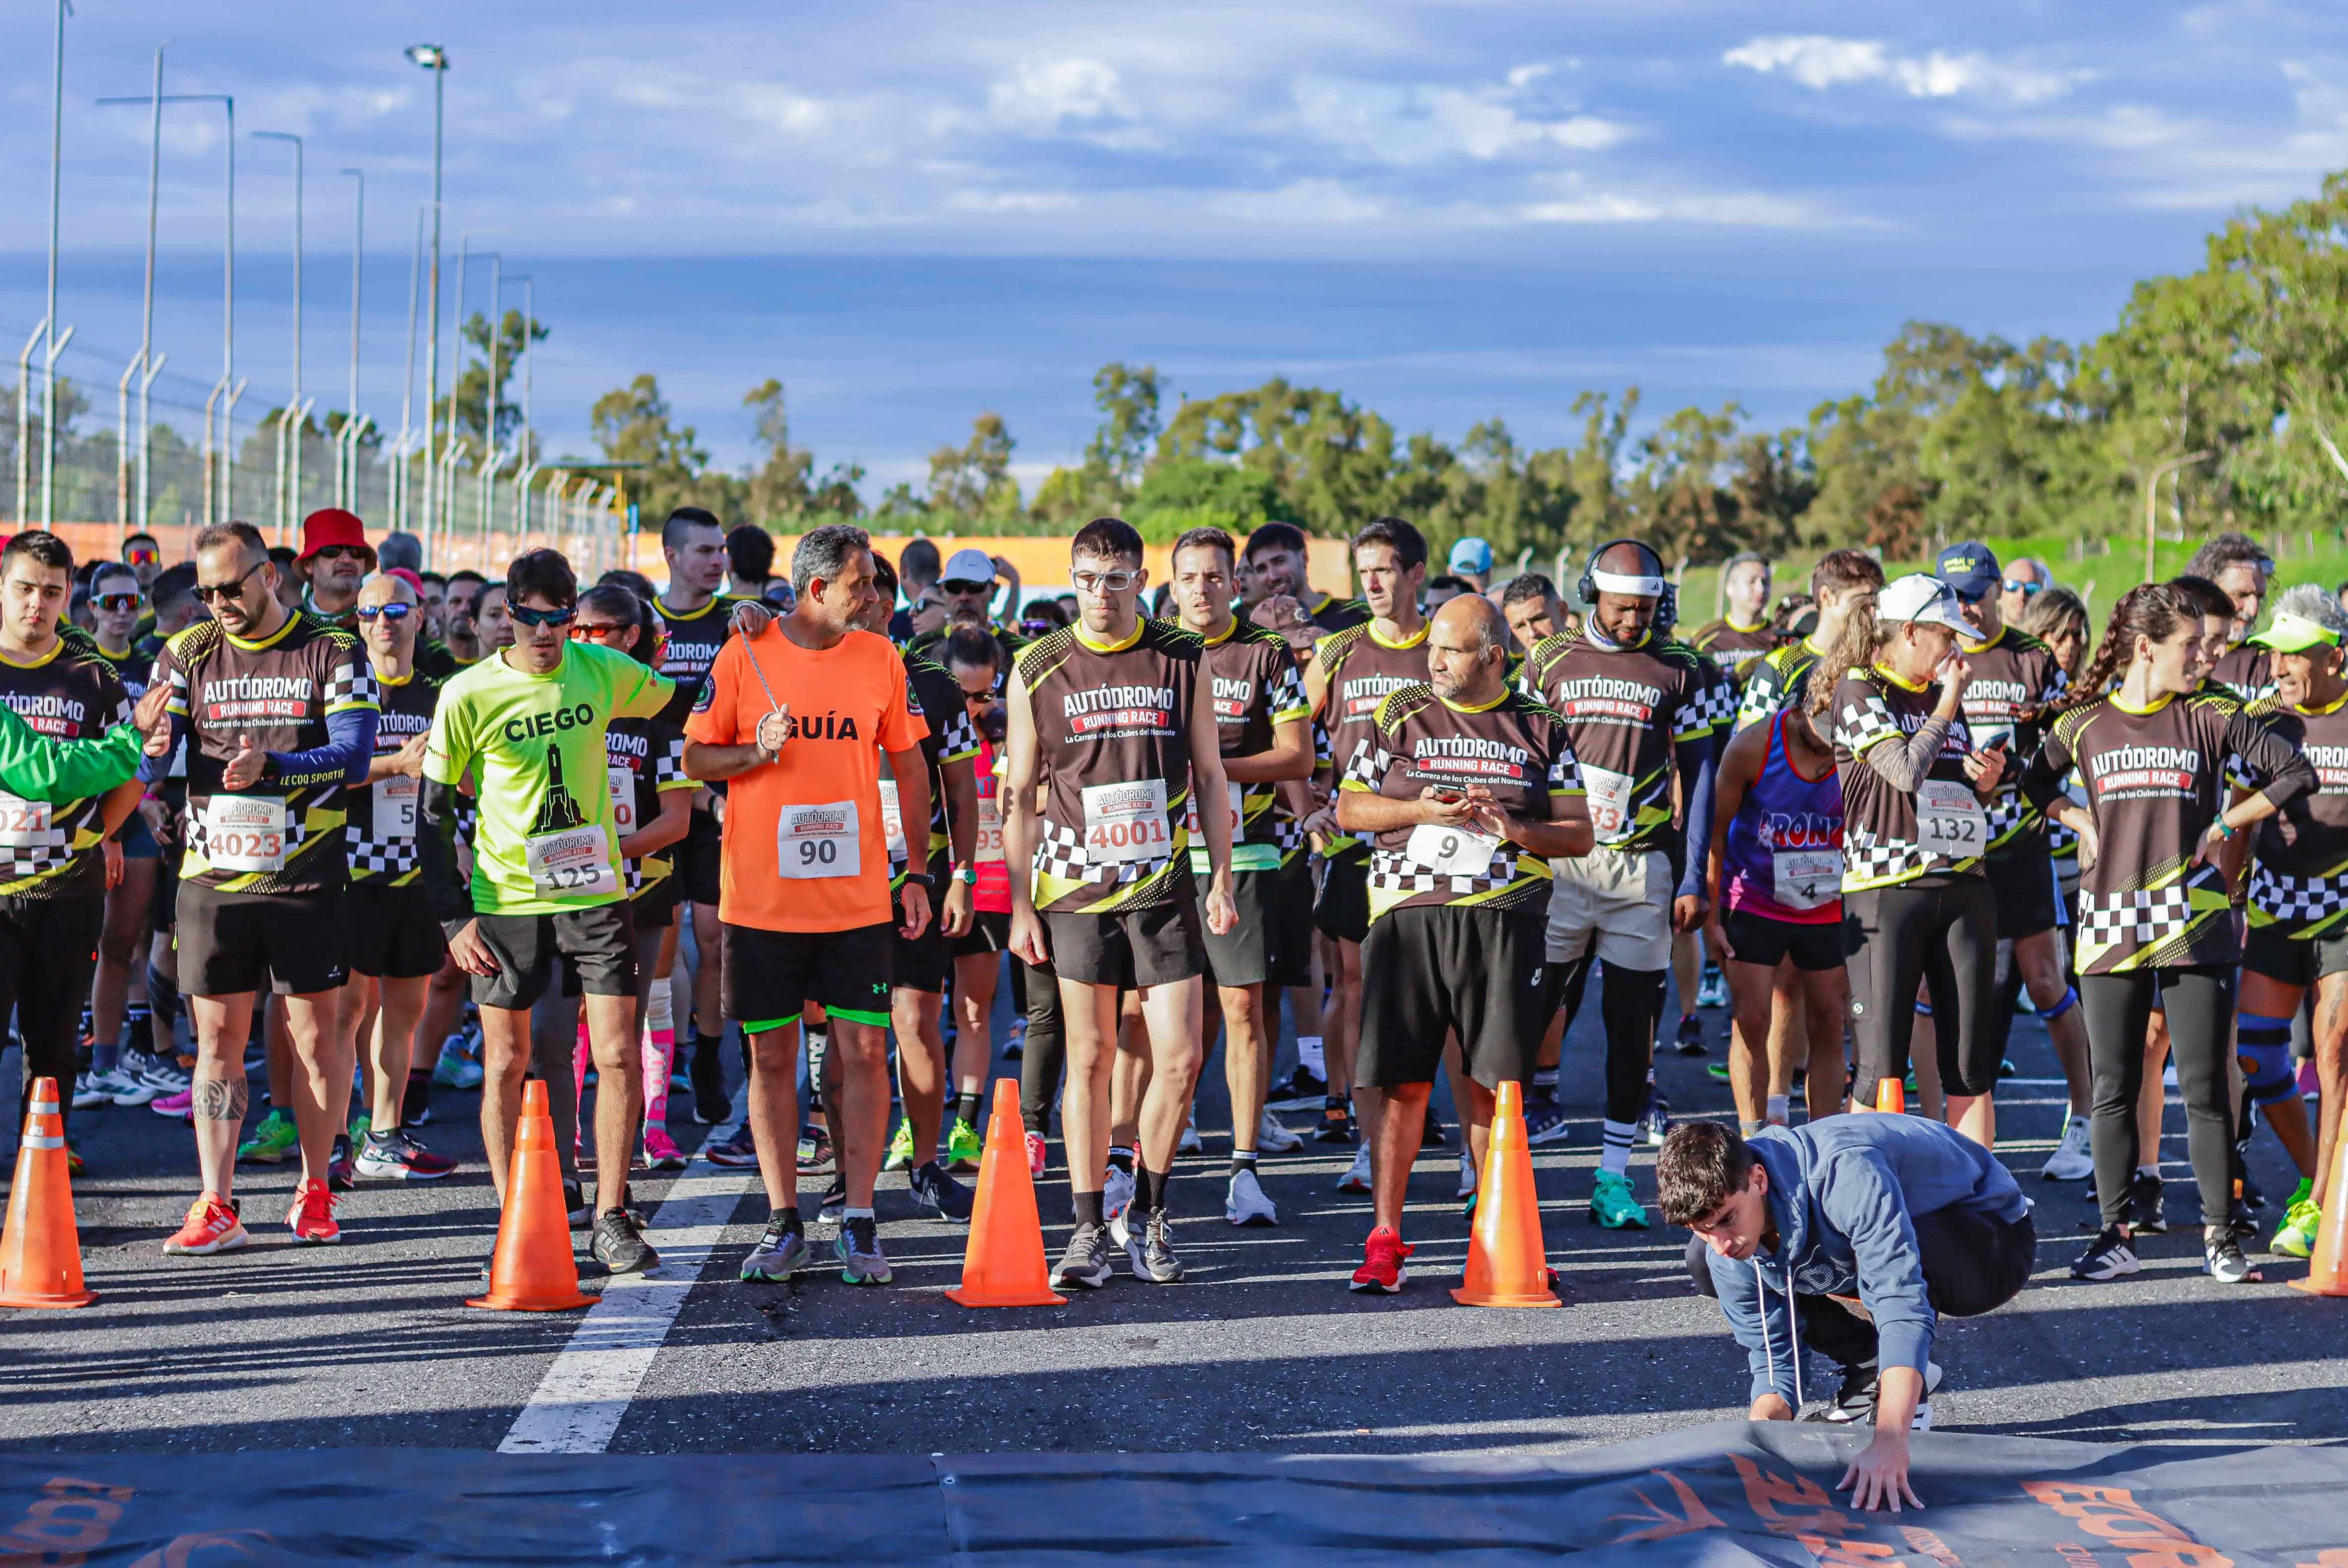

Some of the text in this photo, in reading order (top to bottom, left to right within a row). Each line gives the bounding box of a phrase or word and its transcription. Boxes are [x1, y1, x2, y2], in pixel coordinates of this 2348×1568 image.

[204, 672, 312, 704] AUTÓDROMO
[1561, 674, 1661, 708] AUTÓDROMO
[220, 700, 294, 718] RUNNING RACE
[1063, 683, 1174, 718] AUTÓDROMO
[1574, 700, 1642, 717] RUNNING RACE
[209, 720, 231, 728] Carrera
[252, 718, 273, 727] Clubes
[274, 718, 284, 726] del
[504, 703, 594, 742] CIEGO
[1082, 711, 1158, 729] RUNNING RACE
[1117, 729, 1138, 737] Clubes
[1414, 733, 1529, 765] AUTÓDROMO
[1430, 759, 1510, 774] RUNNING RACE
[2091, 743, 2199, 780] AUTÓDROMO
[311, 768, 345, 784] SPORTIF
[1415, 772, 1441, 781] Carrera
[1442, 773, 1451, 782] de
[1452, 774, 1462, 783] los
[1463, 775, 1487, 784] Clubes
[1501, 778, 1532, 787] Noroeste
[2104, 771, 2180, 789] RUNNING RACE
[1097, 788, 1156, 806] AUTÓDROMO
[2136, 789, 2159, 798] Clubes
[2160, 788, 2170, 796] del
[1107, 802, 1132, 812] RUNNING
[791, 809, 847, 825] AUTÓDROMO
[1090, 818, 1166, 848] 4001
[1930, 817, 1975, 842] 132
[210, 833, 280, 857] 4023
[538, 835, 595, 857] AUTÓDROMO
[800, 840, 837, 865] 90
[1438, 836, 1459, 858] 9
[549, 847, 587, 862] RUNNING RACE
[546, 863, 601, 891] 125
[1800, 883, 1817, 899] 4
